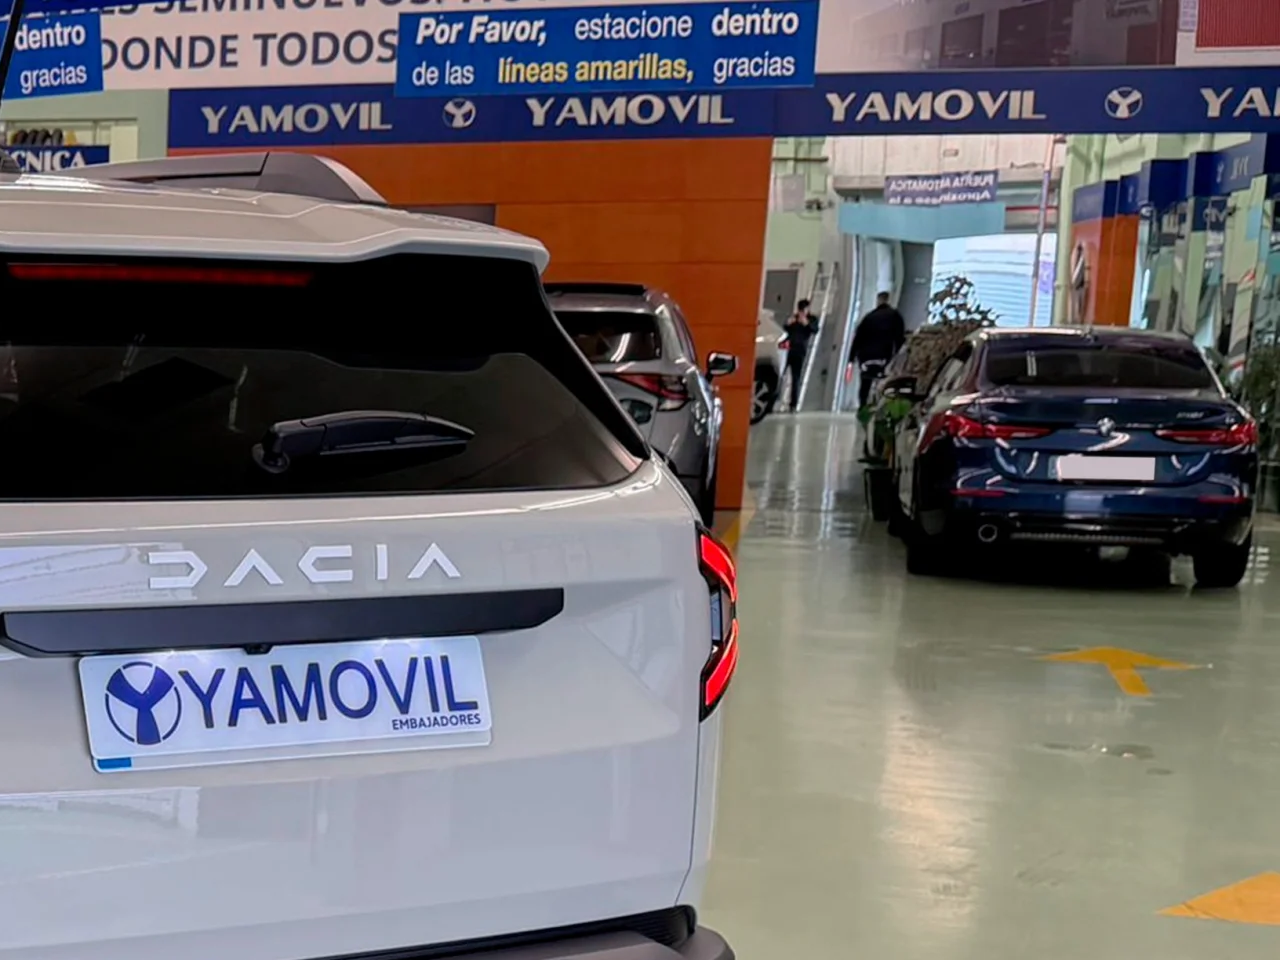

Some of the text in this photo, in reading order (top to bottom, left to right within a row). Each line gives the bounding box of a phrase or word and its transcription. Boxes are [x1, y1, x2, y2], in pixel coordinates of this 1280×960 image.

[15, 22, 85, 51] dentro
[416, 6, 799, 47] Por Favor, estacione dentro
[252, 28, 397, 68] TODOS
[20, 62, 87, 95] gracias
[412, 50, 795, 86] de las líneas amarillas, gracias
[201, 102, 393, 134] YAMOVIL
[526, 93, 734, 127] YAMOVIL
[825, 88, 1047, 123] YAMOVIL
[147, 541, 461, 589] DACIA
[178, 653, 479, 730] YAMOVIL
[391, 713, 482, 731] EMBAJADORES
